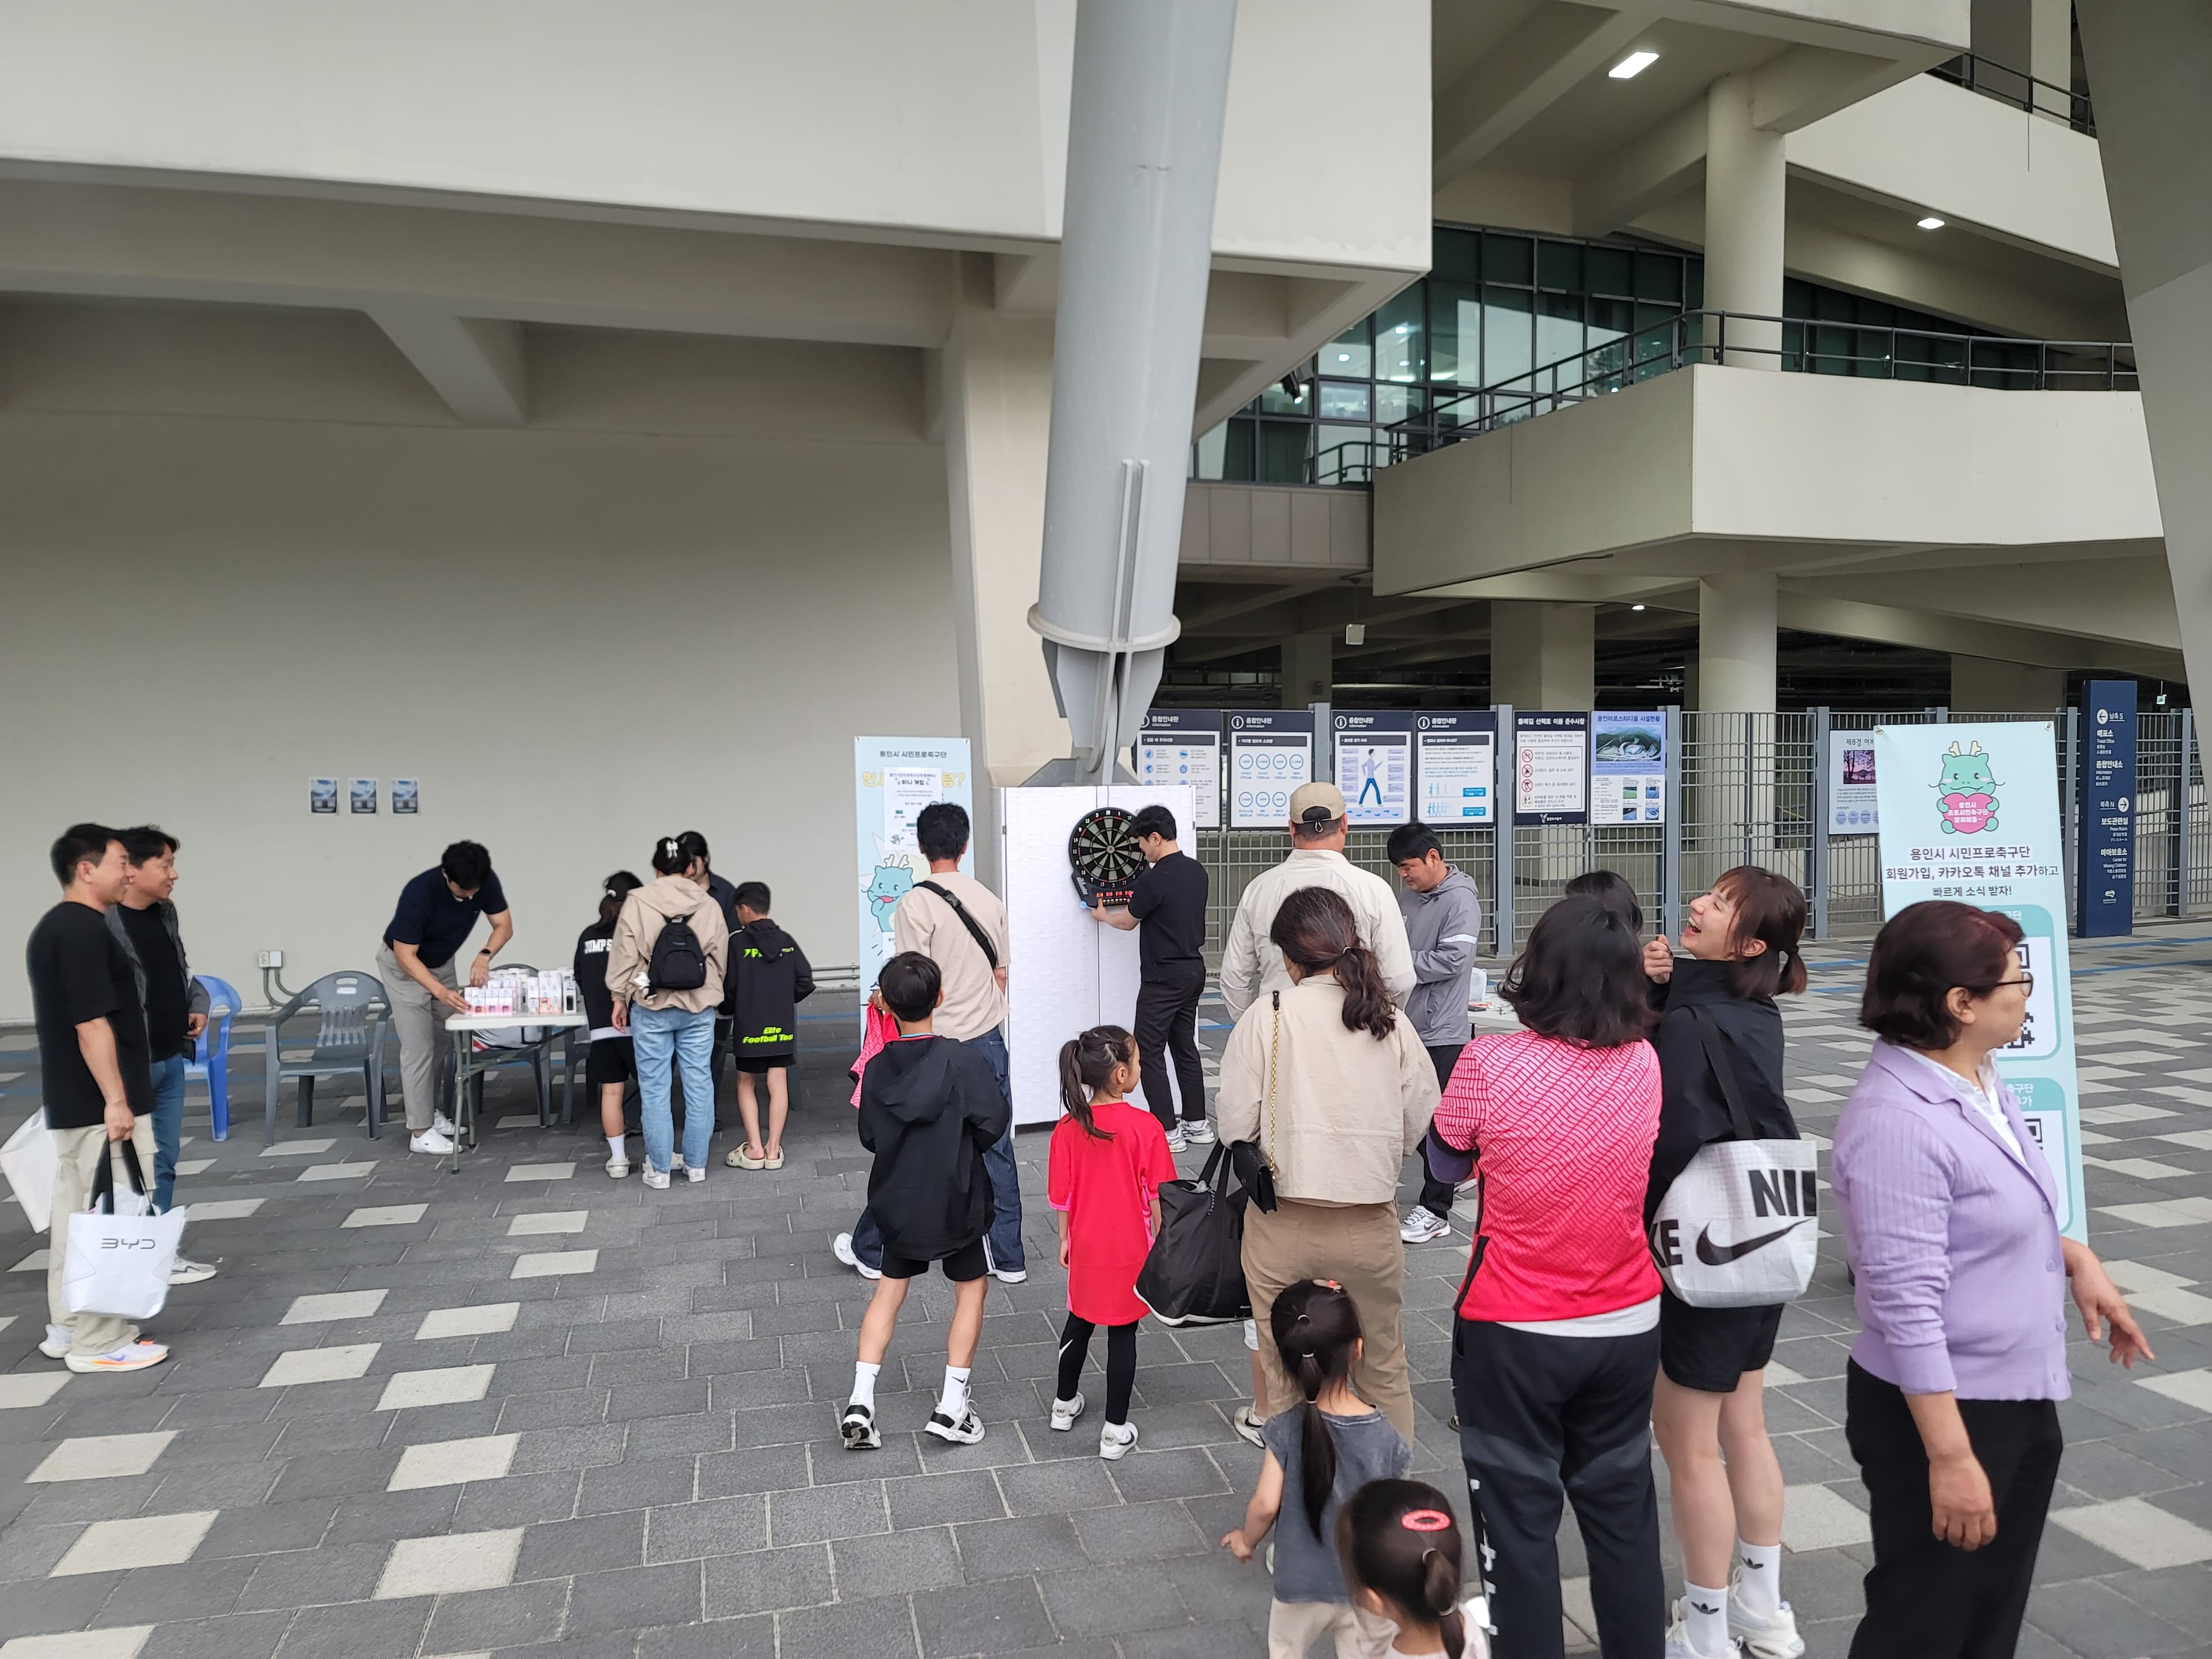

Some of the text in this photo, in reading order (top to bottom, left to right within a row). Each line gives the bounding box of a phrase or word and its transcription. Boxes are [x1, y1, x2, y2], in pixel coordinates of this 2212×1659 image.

[2097, 729, 2113, 737] 매표소
[1846, 738, 1861, 747] 제8경
[2096, 760, 2123, 768] 종합안내소
[1910, 846, 2031, 861] 용인시 시민프로축구단
[2100, 848, 2127, 856] 미아보호소
[1886, 864, 2059, 880] 회원가입, 카카오톡 채널 추가하고
[1933, 885, 2012, 897] 빠르게 소식 받자!
[743, 1035, 778, 1043] Football
[2018, 1095, 2033, 1107] 가
[101, 1238, 156, 1249] BYD
